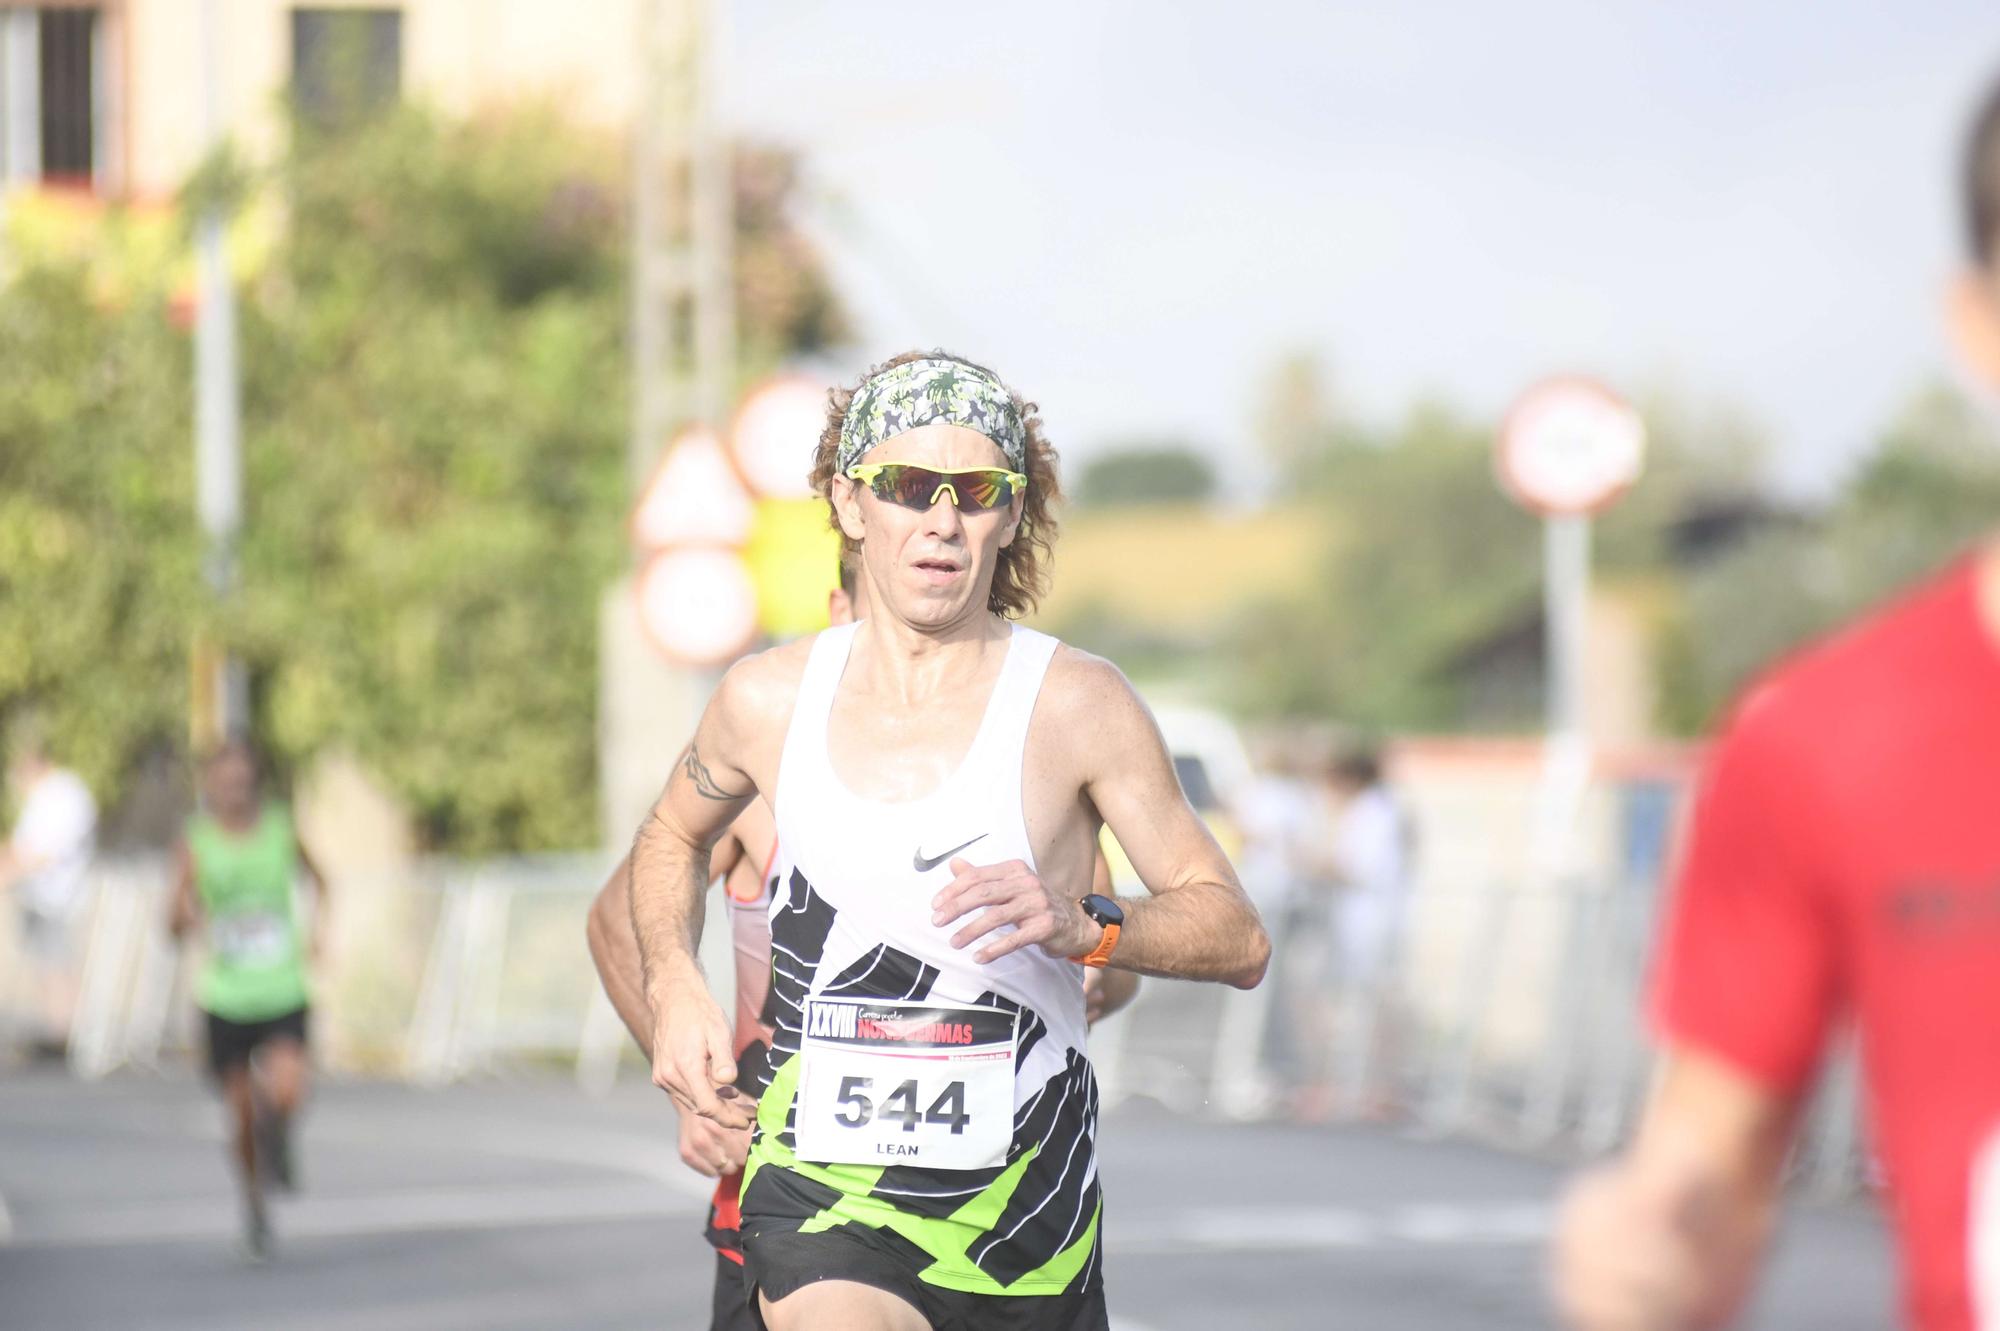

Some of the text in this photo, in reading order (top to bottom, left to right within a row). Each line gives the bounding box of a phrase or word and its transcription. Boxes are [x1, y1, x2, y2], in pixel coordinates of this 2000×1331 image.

[809, 1002, 857, 1039] XXVIII
[857, 1020, 972, 1044] NOERMAS
[834, 1076, 970, 1135] 544
[877, 1143, 919, 1156] LEAN
